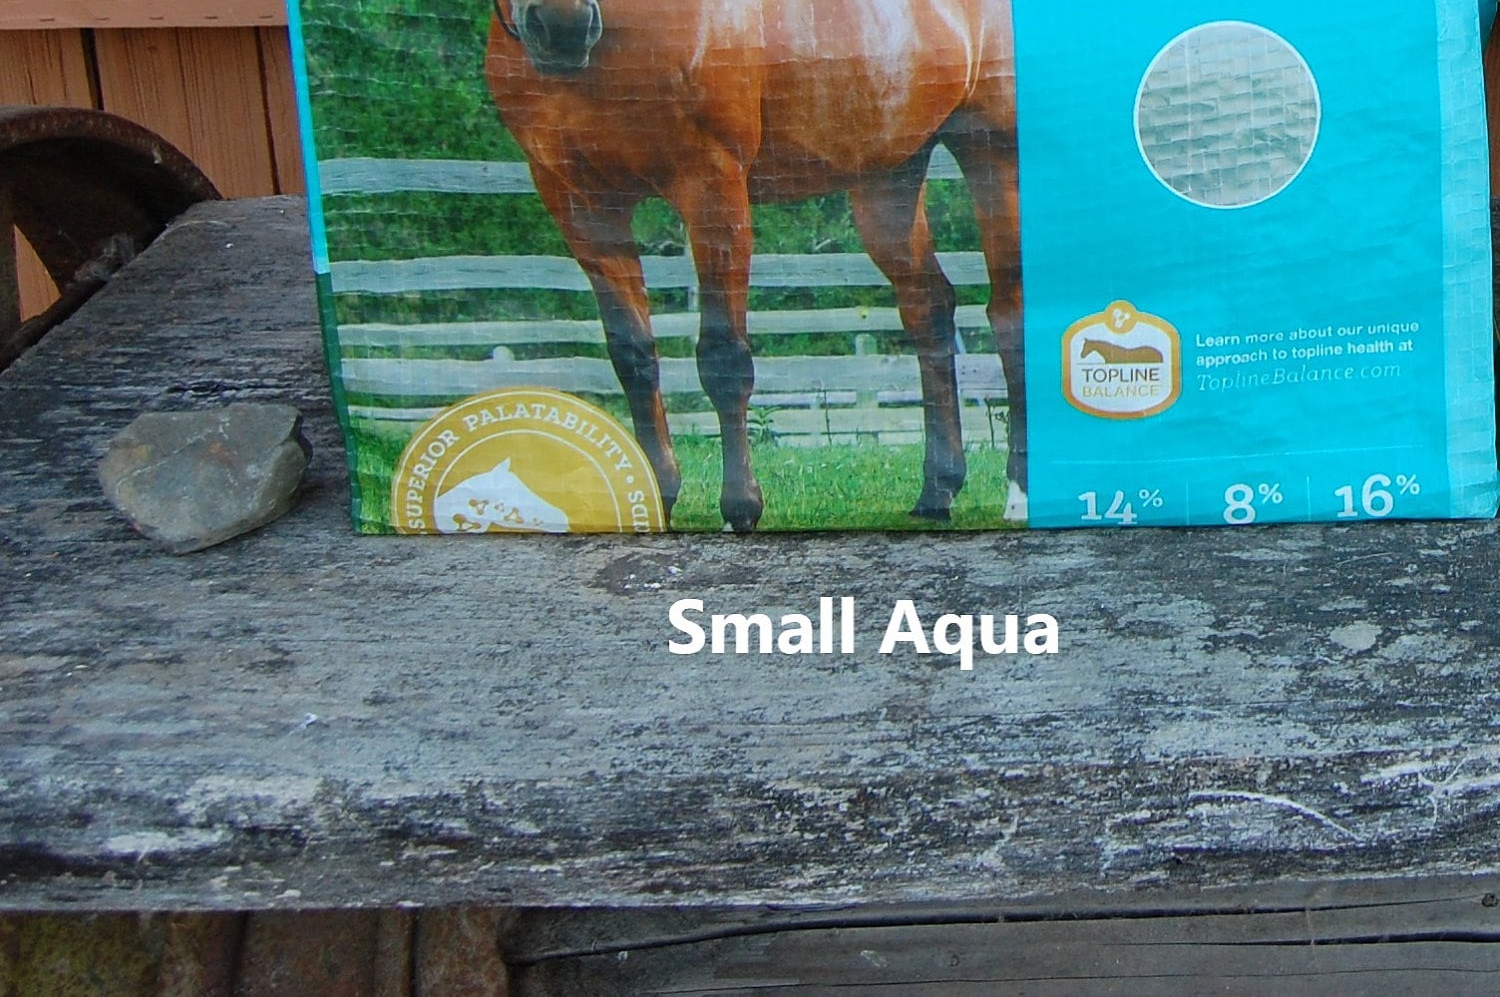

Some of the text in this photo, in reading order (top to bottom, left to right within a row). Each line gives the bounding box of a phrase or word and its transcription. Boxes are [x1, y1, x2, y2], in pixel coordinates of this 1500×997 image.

[1196, 321, 1419, 348] Learn more about our unique
[1196, 339, 1413, 368] approach to topline health at
[1081, 367, 1160, 384] TOPLINE
[1196, 363, 1401, 393] ToplineBalance.com
[1081, 384, 1160, 398] BALANCE
[405, 401, 633, 529] SUPERIOR PALATABILITY
[1223, 482, 1283, 524] 8%
[1334, 473, 1420, 518] 16%
